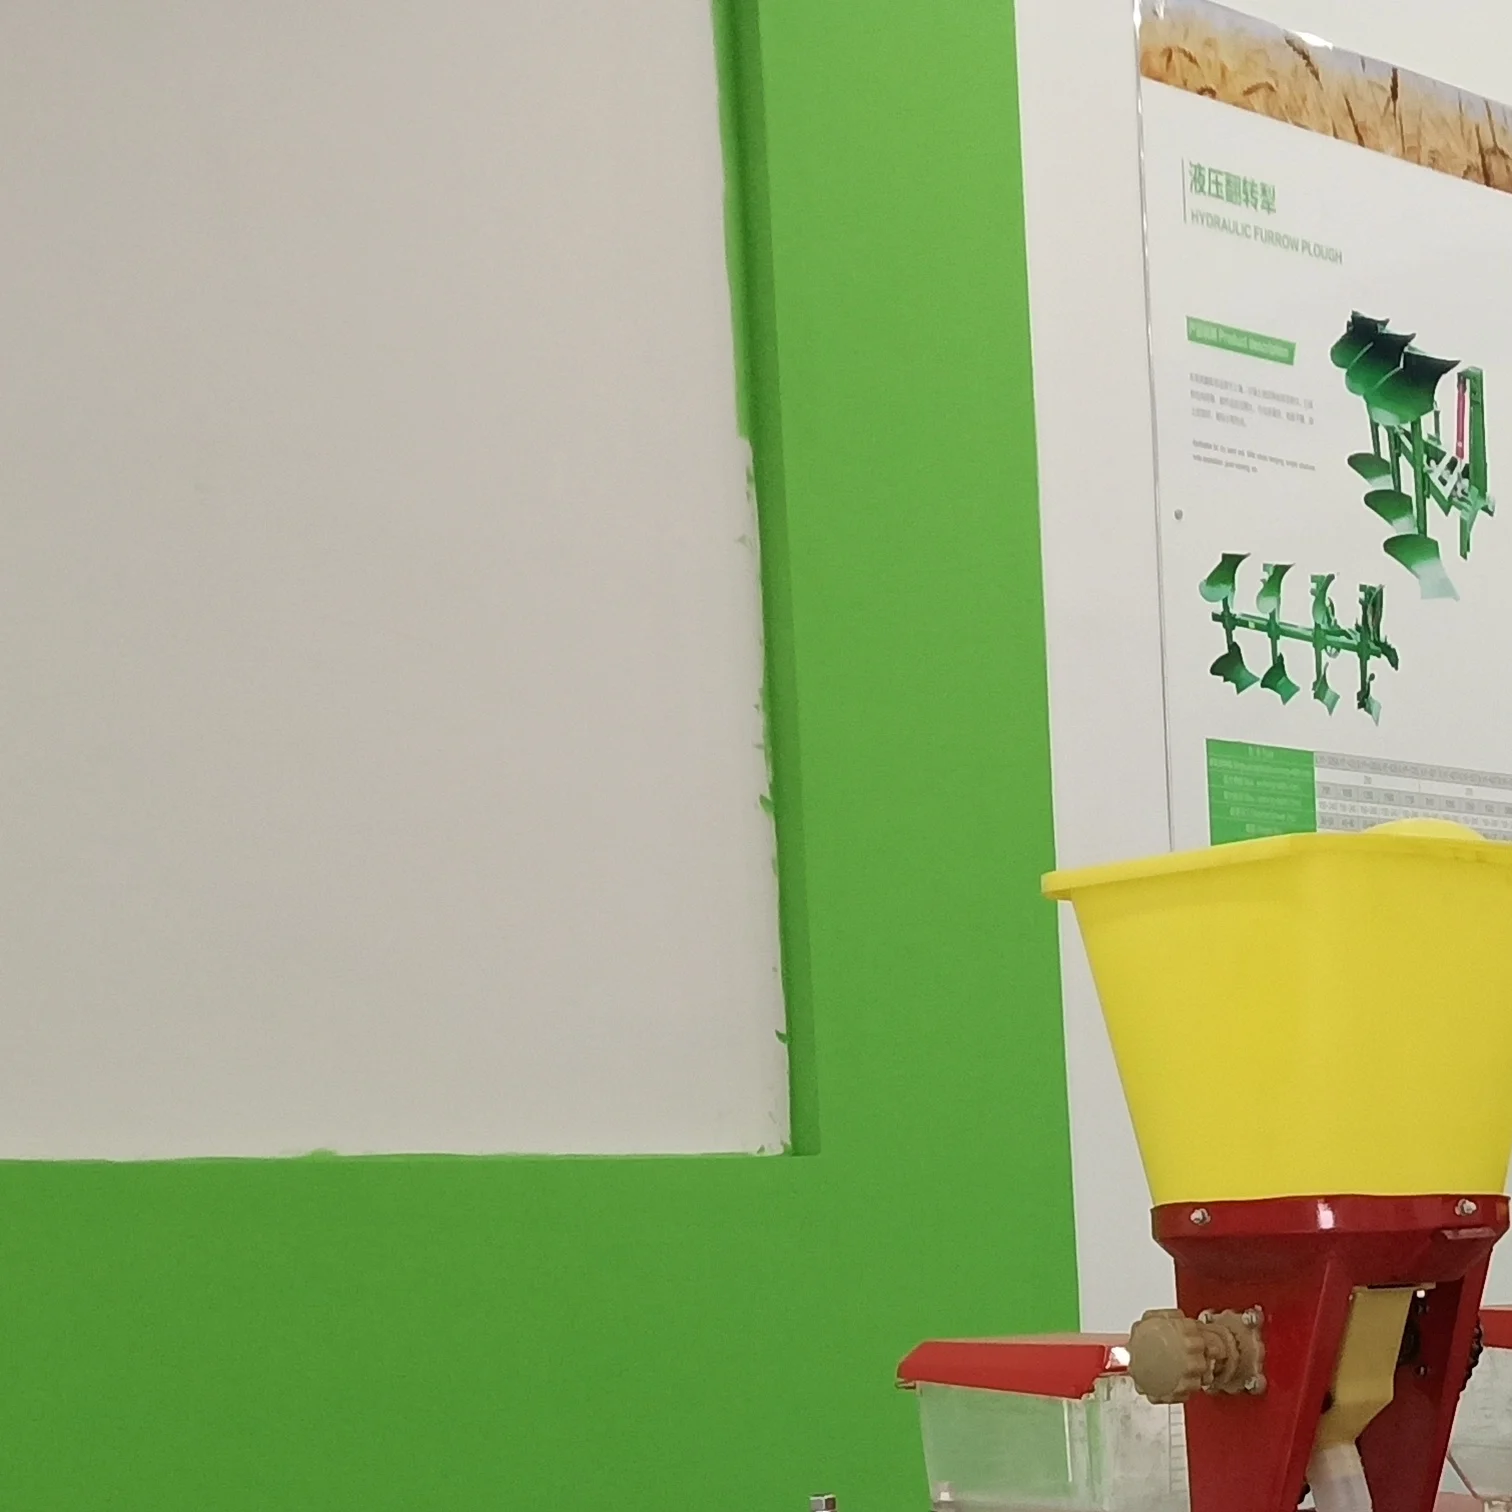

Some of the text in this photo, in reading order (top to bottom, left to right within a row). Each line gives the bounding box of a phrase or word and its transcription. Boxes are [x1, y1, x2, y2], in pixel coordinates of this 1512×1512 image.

[1189, 160, 1277, 215] 液压翻转犁
[1190, 209, 1343, 265] HYDRAULIC FURROW PLOUGH
